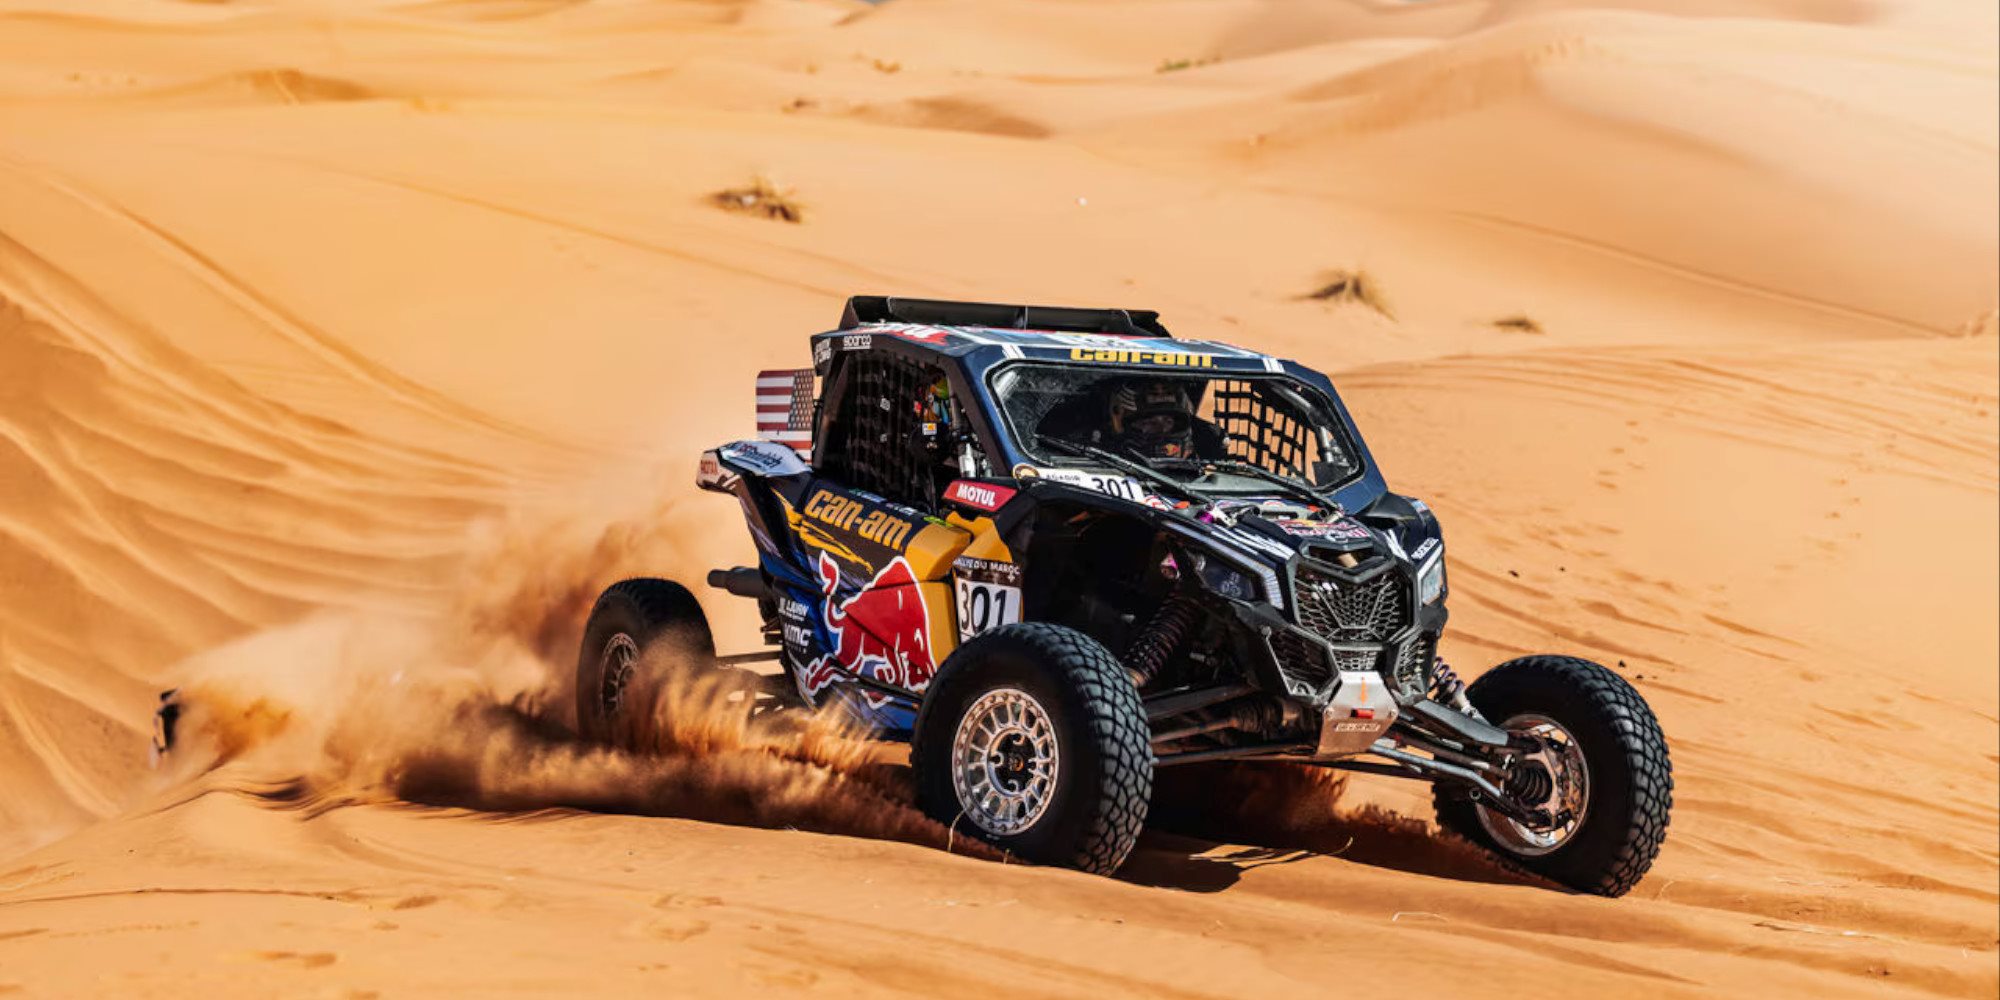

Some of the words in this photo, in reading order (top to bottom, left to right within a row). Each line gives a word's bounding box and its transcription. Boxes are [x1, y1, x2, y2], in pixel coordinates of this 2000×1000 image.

[956, 482, 996, 507] MOTUL
[1091, 477, 1135, 500] 301
[804, 489, 912, 553] can-am
[961, 582, 1007, 634] 301
